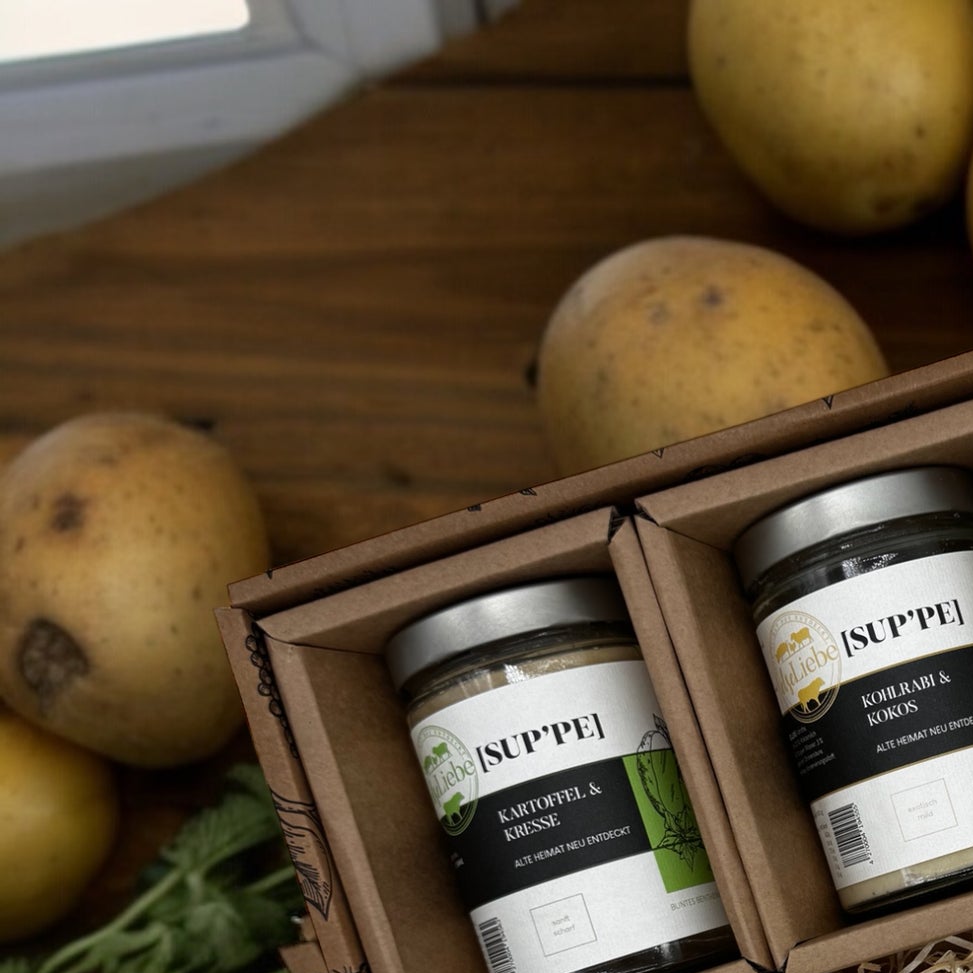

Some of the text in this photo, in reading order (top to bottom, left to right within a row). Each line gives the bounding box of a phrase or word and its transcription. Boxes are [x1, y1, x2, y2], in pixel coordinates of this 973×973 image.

[841, 599, 965, 658] [SUP'PE]
[861, 670, 951, 708] KOHLRABI &
[867, 700, 919, 727] KOKOS
[476, 713, 605, 773] [SUP'PE]
[877, 740, 896, 753] ALTE
[896, 730, 928, 746] HEIMAT
[929, 723, 948, 736] NEU
[497, 782, 602, 824] KARTOFFEL &
[504, 813, 561, 842] KRESSE
[515, 826, 631, 868] ALTE HEIMAT NEU ENTDECKT
